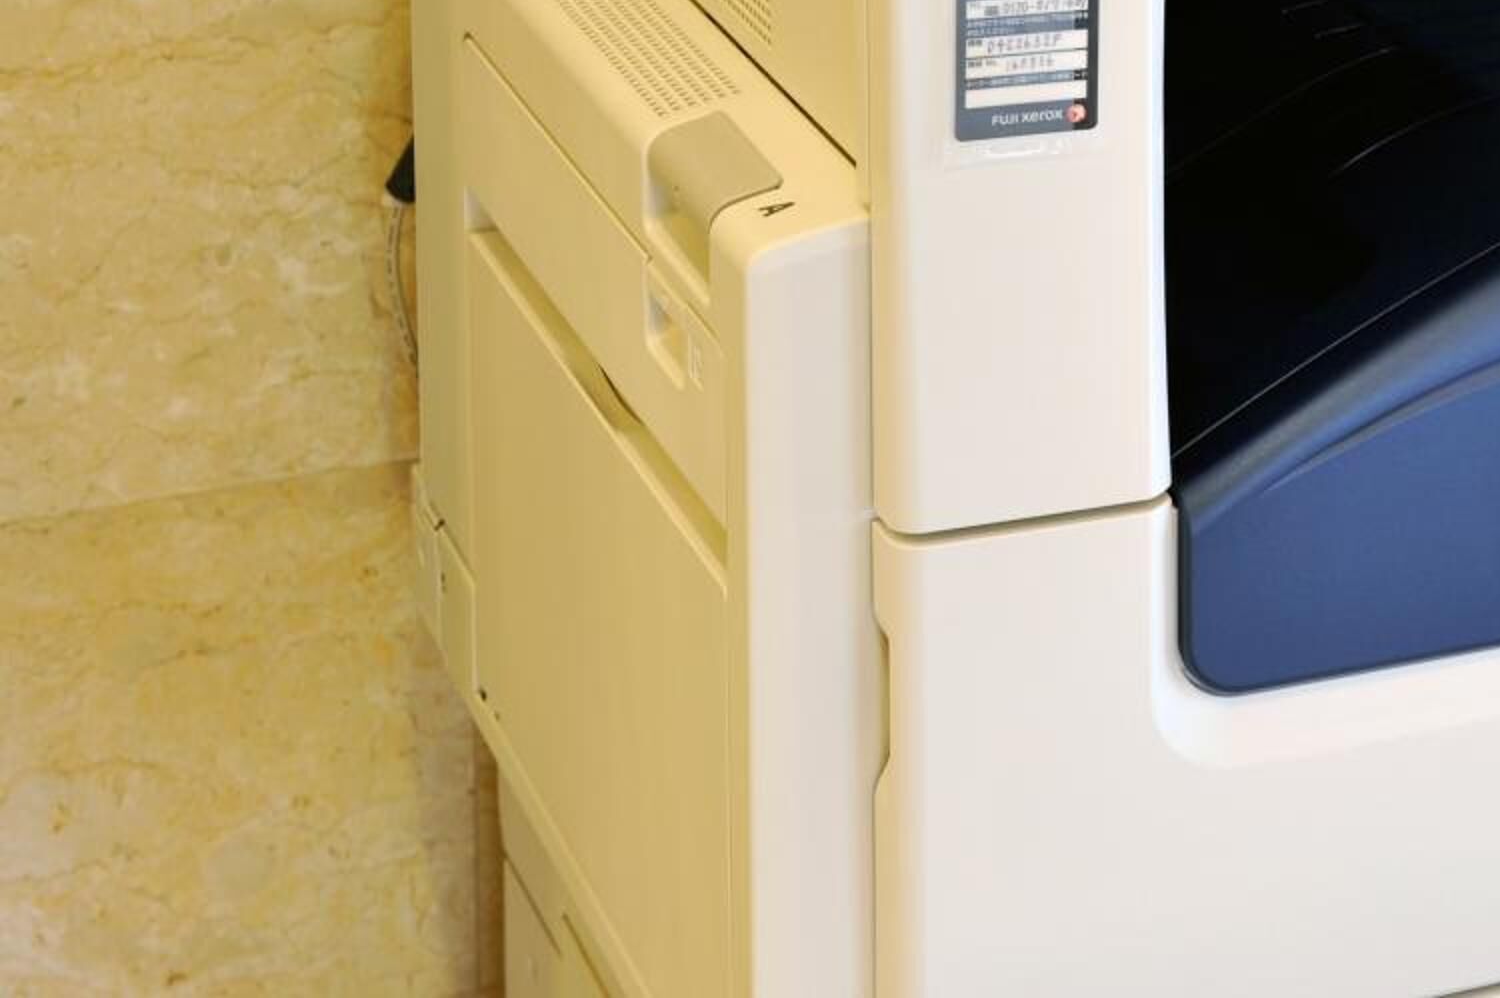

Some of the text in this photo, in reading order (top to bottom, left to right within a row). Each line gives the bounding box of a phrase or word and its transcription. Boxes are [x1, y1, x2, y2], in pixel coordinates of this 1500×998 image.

[992, 107, 1063, 126] FUJI xerox
[758, 201, 796, 218] A
